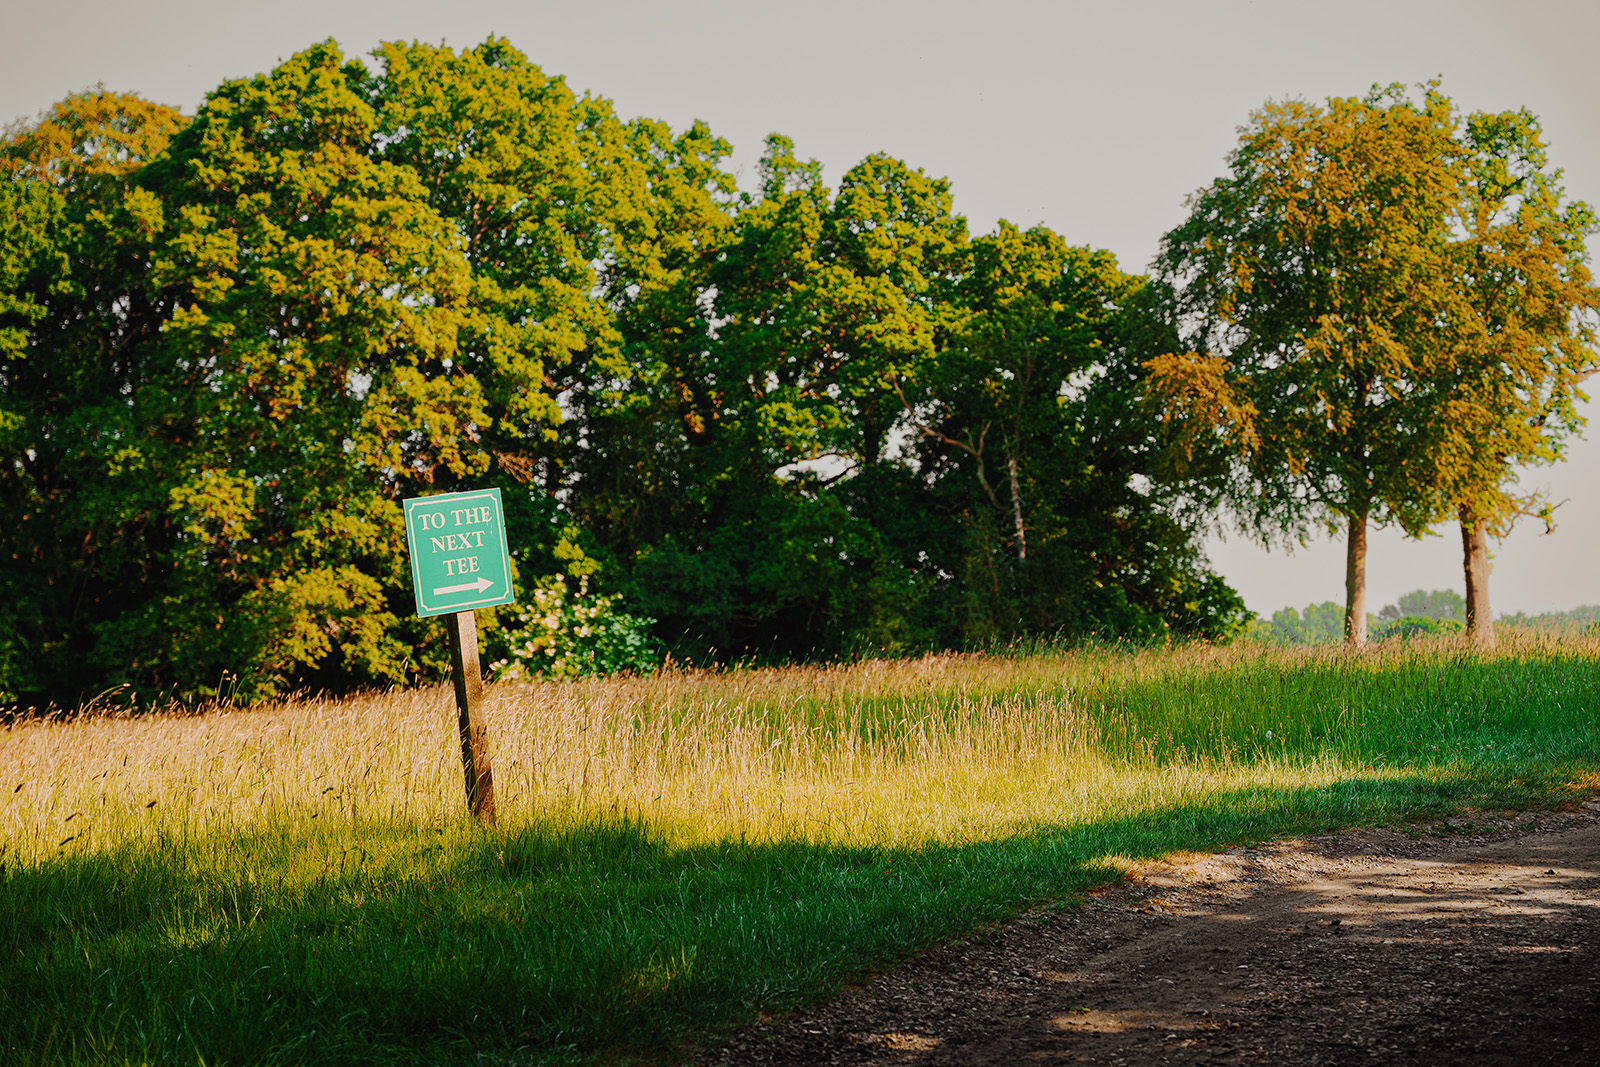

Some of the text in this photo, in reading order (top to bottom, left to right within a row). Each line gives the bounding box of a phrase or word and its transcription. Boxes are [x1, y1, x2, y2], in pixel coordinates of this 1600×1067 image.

[418, 506, 492, 531] TO THE
[430, 530, 485, 553] NEXT
[442, 556, 480, 576] TEE
